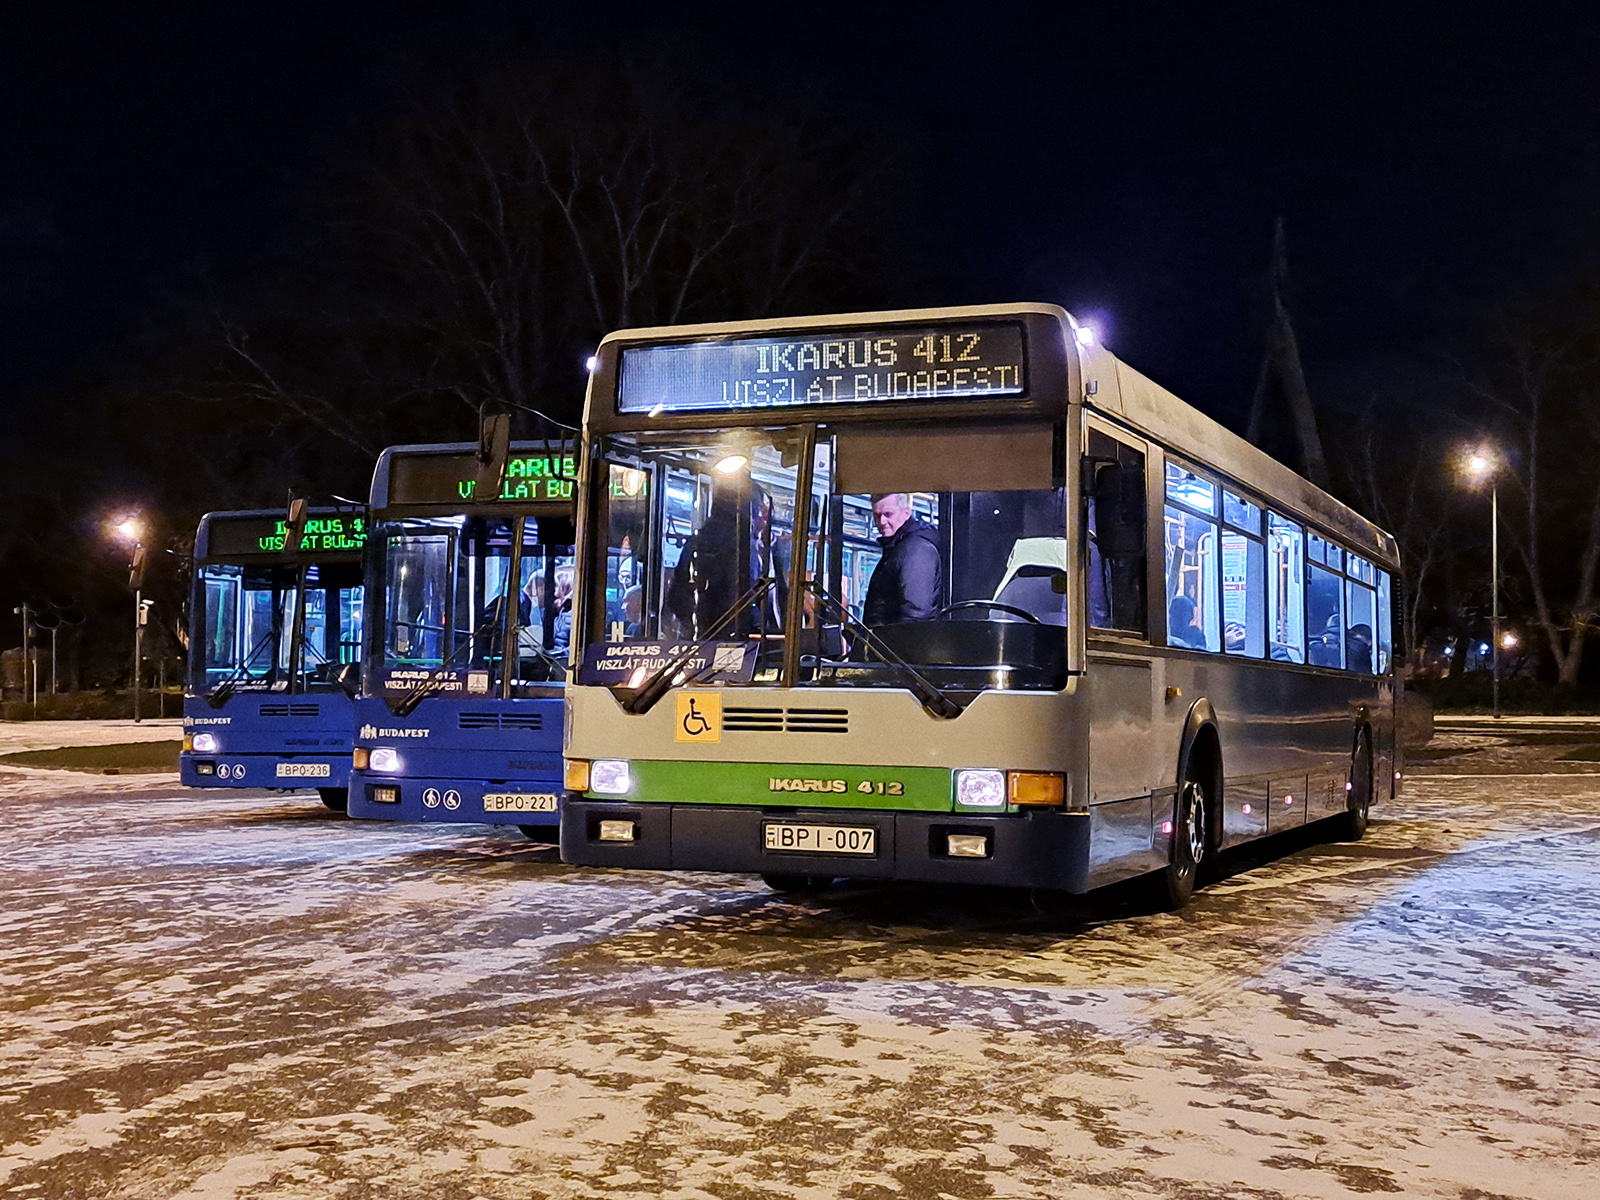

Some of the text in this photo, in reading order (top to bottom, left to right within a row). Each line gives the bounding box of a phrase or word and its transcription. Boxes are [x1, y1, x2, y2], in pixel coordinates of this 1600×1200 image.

[756, 333, 981, 374] IKARUS 412
[505, 457, 575, 478] ARUS
[275, 519, 343, 535] IRUS
[259, 535, 318, 550] VISÁT
[606, 645, 661, 656] IKARUS
[596, 657, 641, 671] VISZLÁT
[379, 729, 430, 738] BUDAPEST
[769, 778, 904, 796] IKARUS 412
[495, 796, 554, 809] BPO-221
[781, 828, 872, 850] BPI-007
